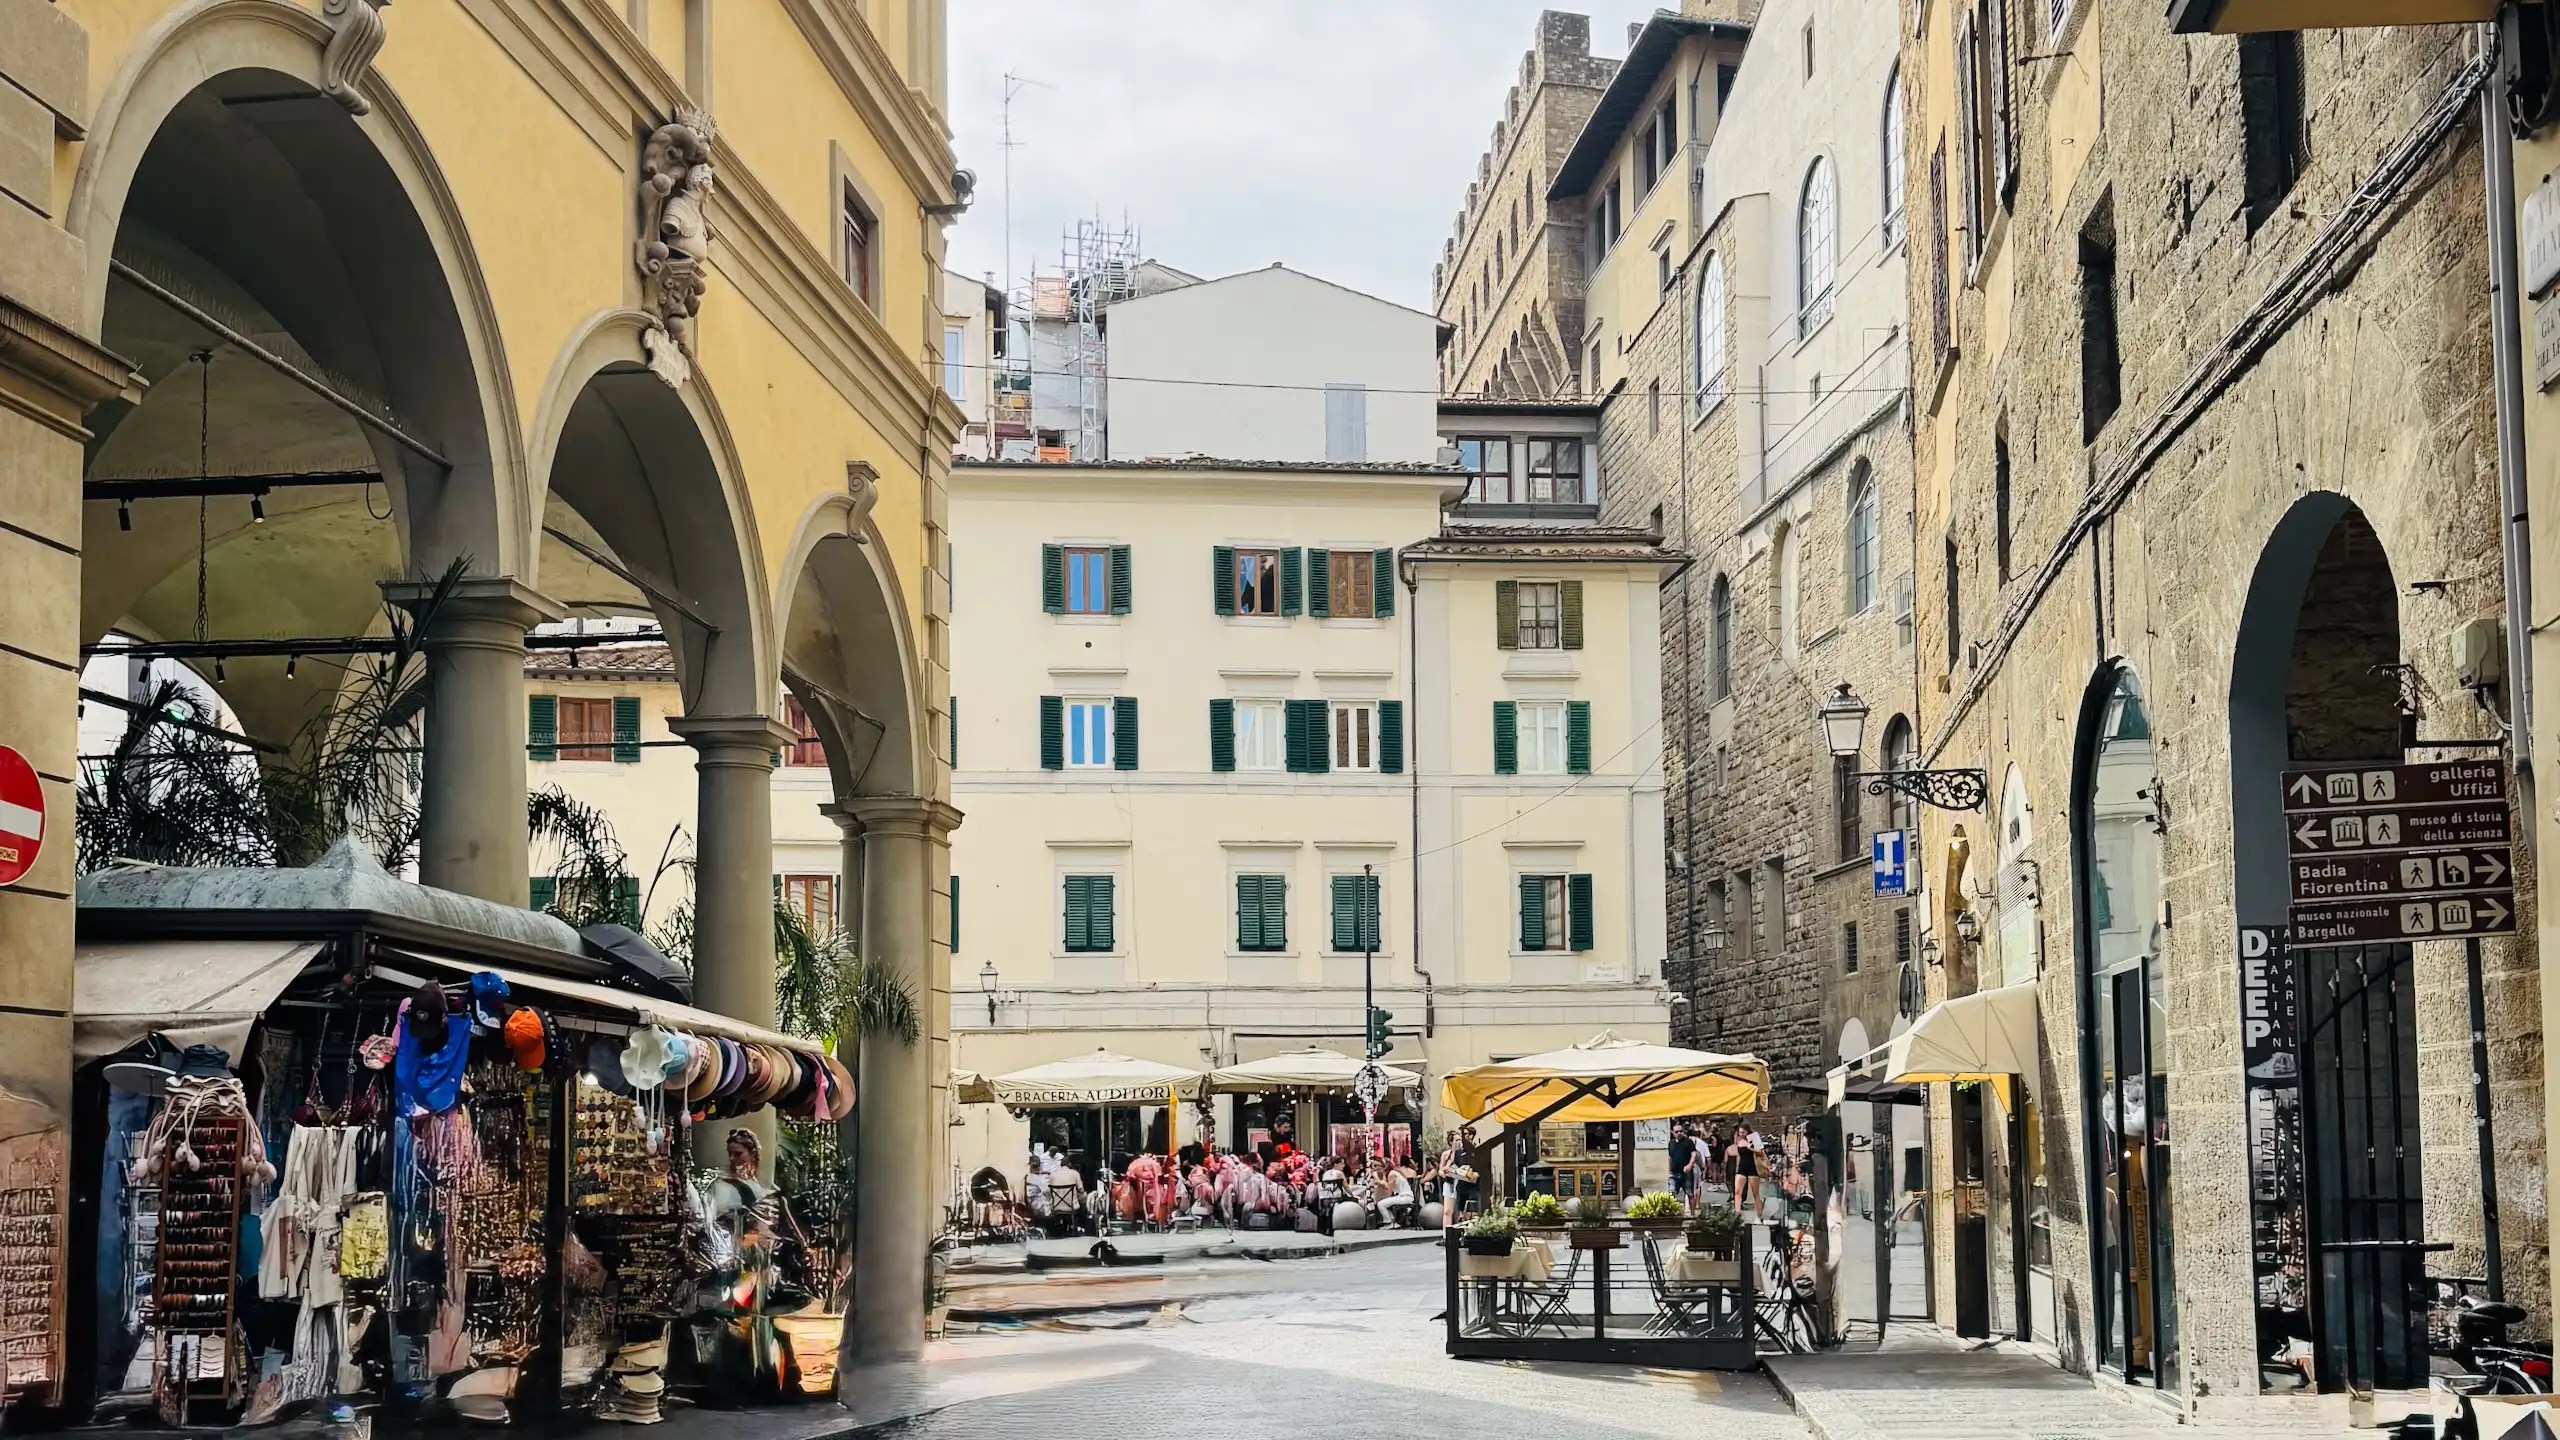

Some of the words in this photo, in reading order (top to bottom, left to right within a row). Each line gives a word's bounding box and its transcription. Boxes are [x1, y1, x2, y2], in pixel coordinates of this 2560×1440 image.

[2430, 765, 2496, 783] galleria
[2450, 783, 2498, 797] Uffizi
[2409, 815, 2446, 827] museo
[2451, 813, 2462, 824] di
[2467, 811, 2502, 823] storia
[2424, 830, 2454, 841] della
[2459, 828, 2503, 839] scienza
[2299, 866, 2347, 879] Badia
[2300, 879, 2389, 896] Fiorentina
[2297, 910, 2332, 921] museo
[2336, 906, 2390, 919] nazionale
[2298, 924, 2356, 940] Bargello
[2242, 929, 2271, 1048] DEEP
[2270, 929, 2282, 1048] ITALIAN
[1015, 1091, 1079, 1102] BRACERIA
